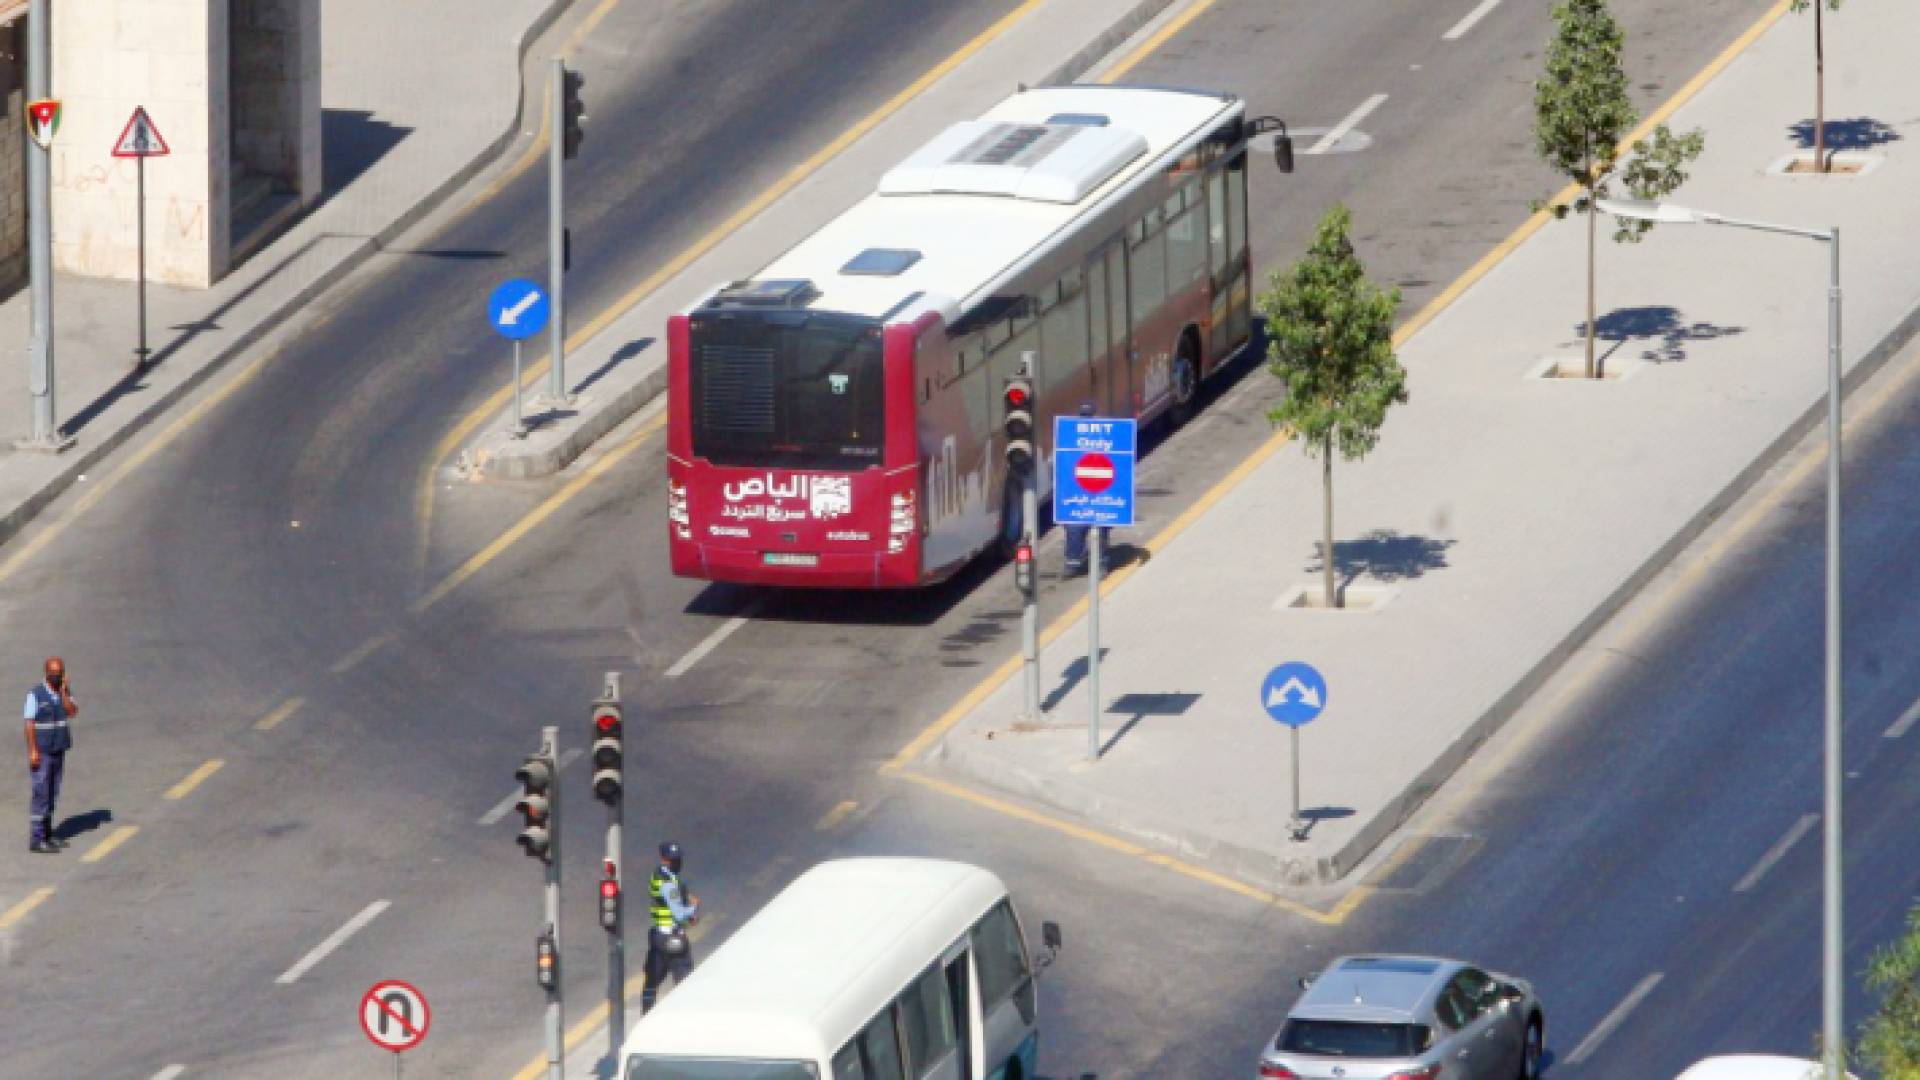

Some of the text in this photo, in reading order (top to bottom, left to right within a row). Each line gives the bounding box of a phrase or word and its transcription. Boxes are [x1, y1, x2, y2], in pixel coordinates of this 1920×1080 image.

[1077, 423, 1113, 433] BRT
[1077, 437, 1113, 452] Only
[725, 472, 808, 504] الباص
[723, 505, 806, 521] سريع التردد
